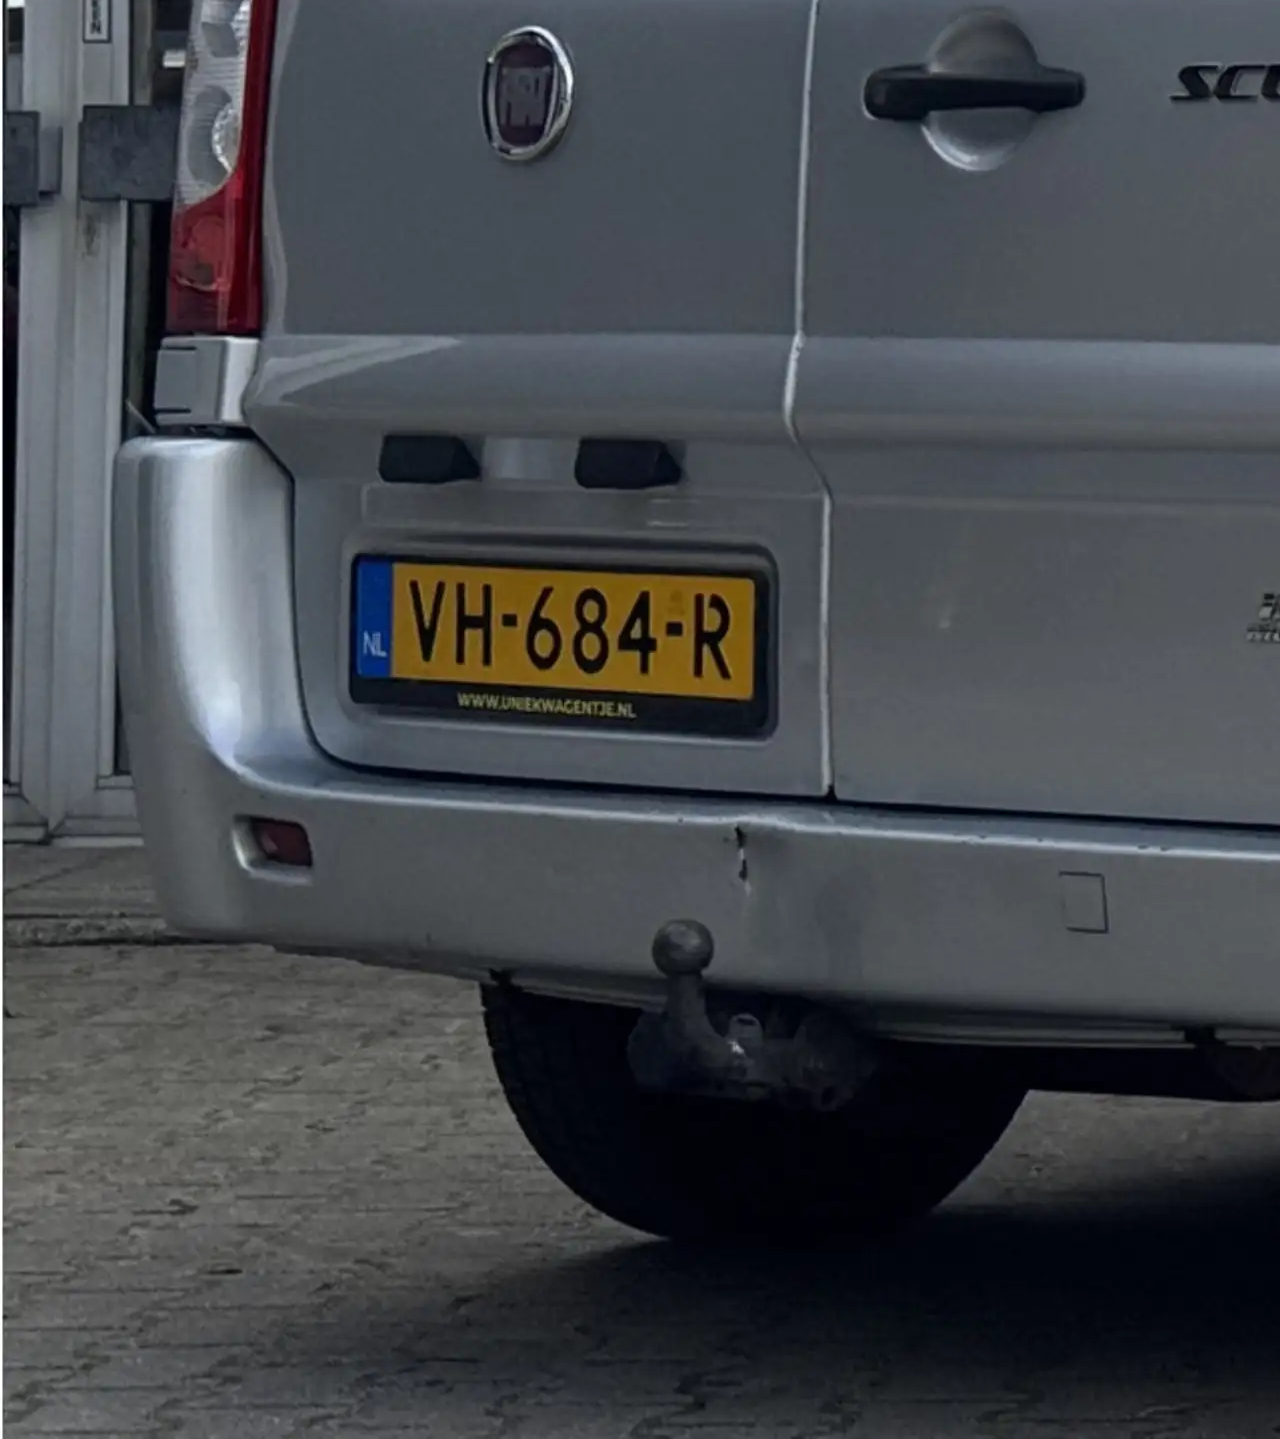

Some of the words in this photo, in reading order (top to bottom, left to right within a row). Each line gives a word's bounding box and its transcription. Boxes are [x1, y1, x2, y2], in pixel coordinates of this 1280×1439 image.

[409, 579, 732, 680] VH-684-R
[362, 631, 388, 658] NL
[457, 692, 638, 719] WWW.UNIEKWAGENTJE.NL
